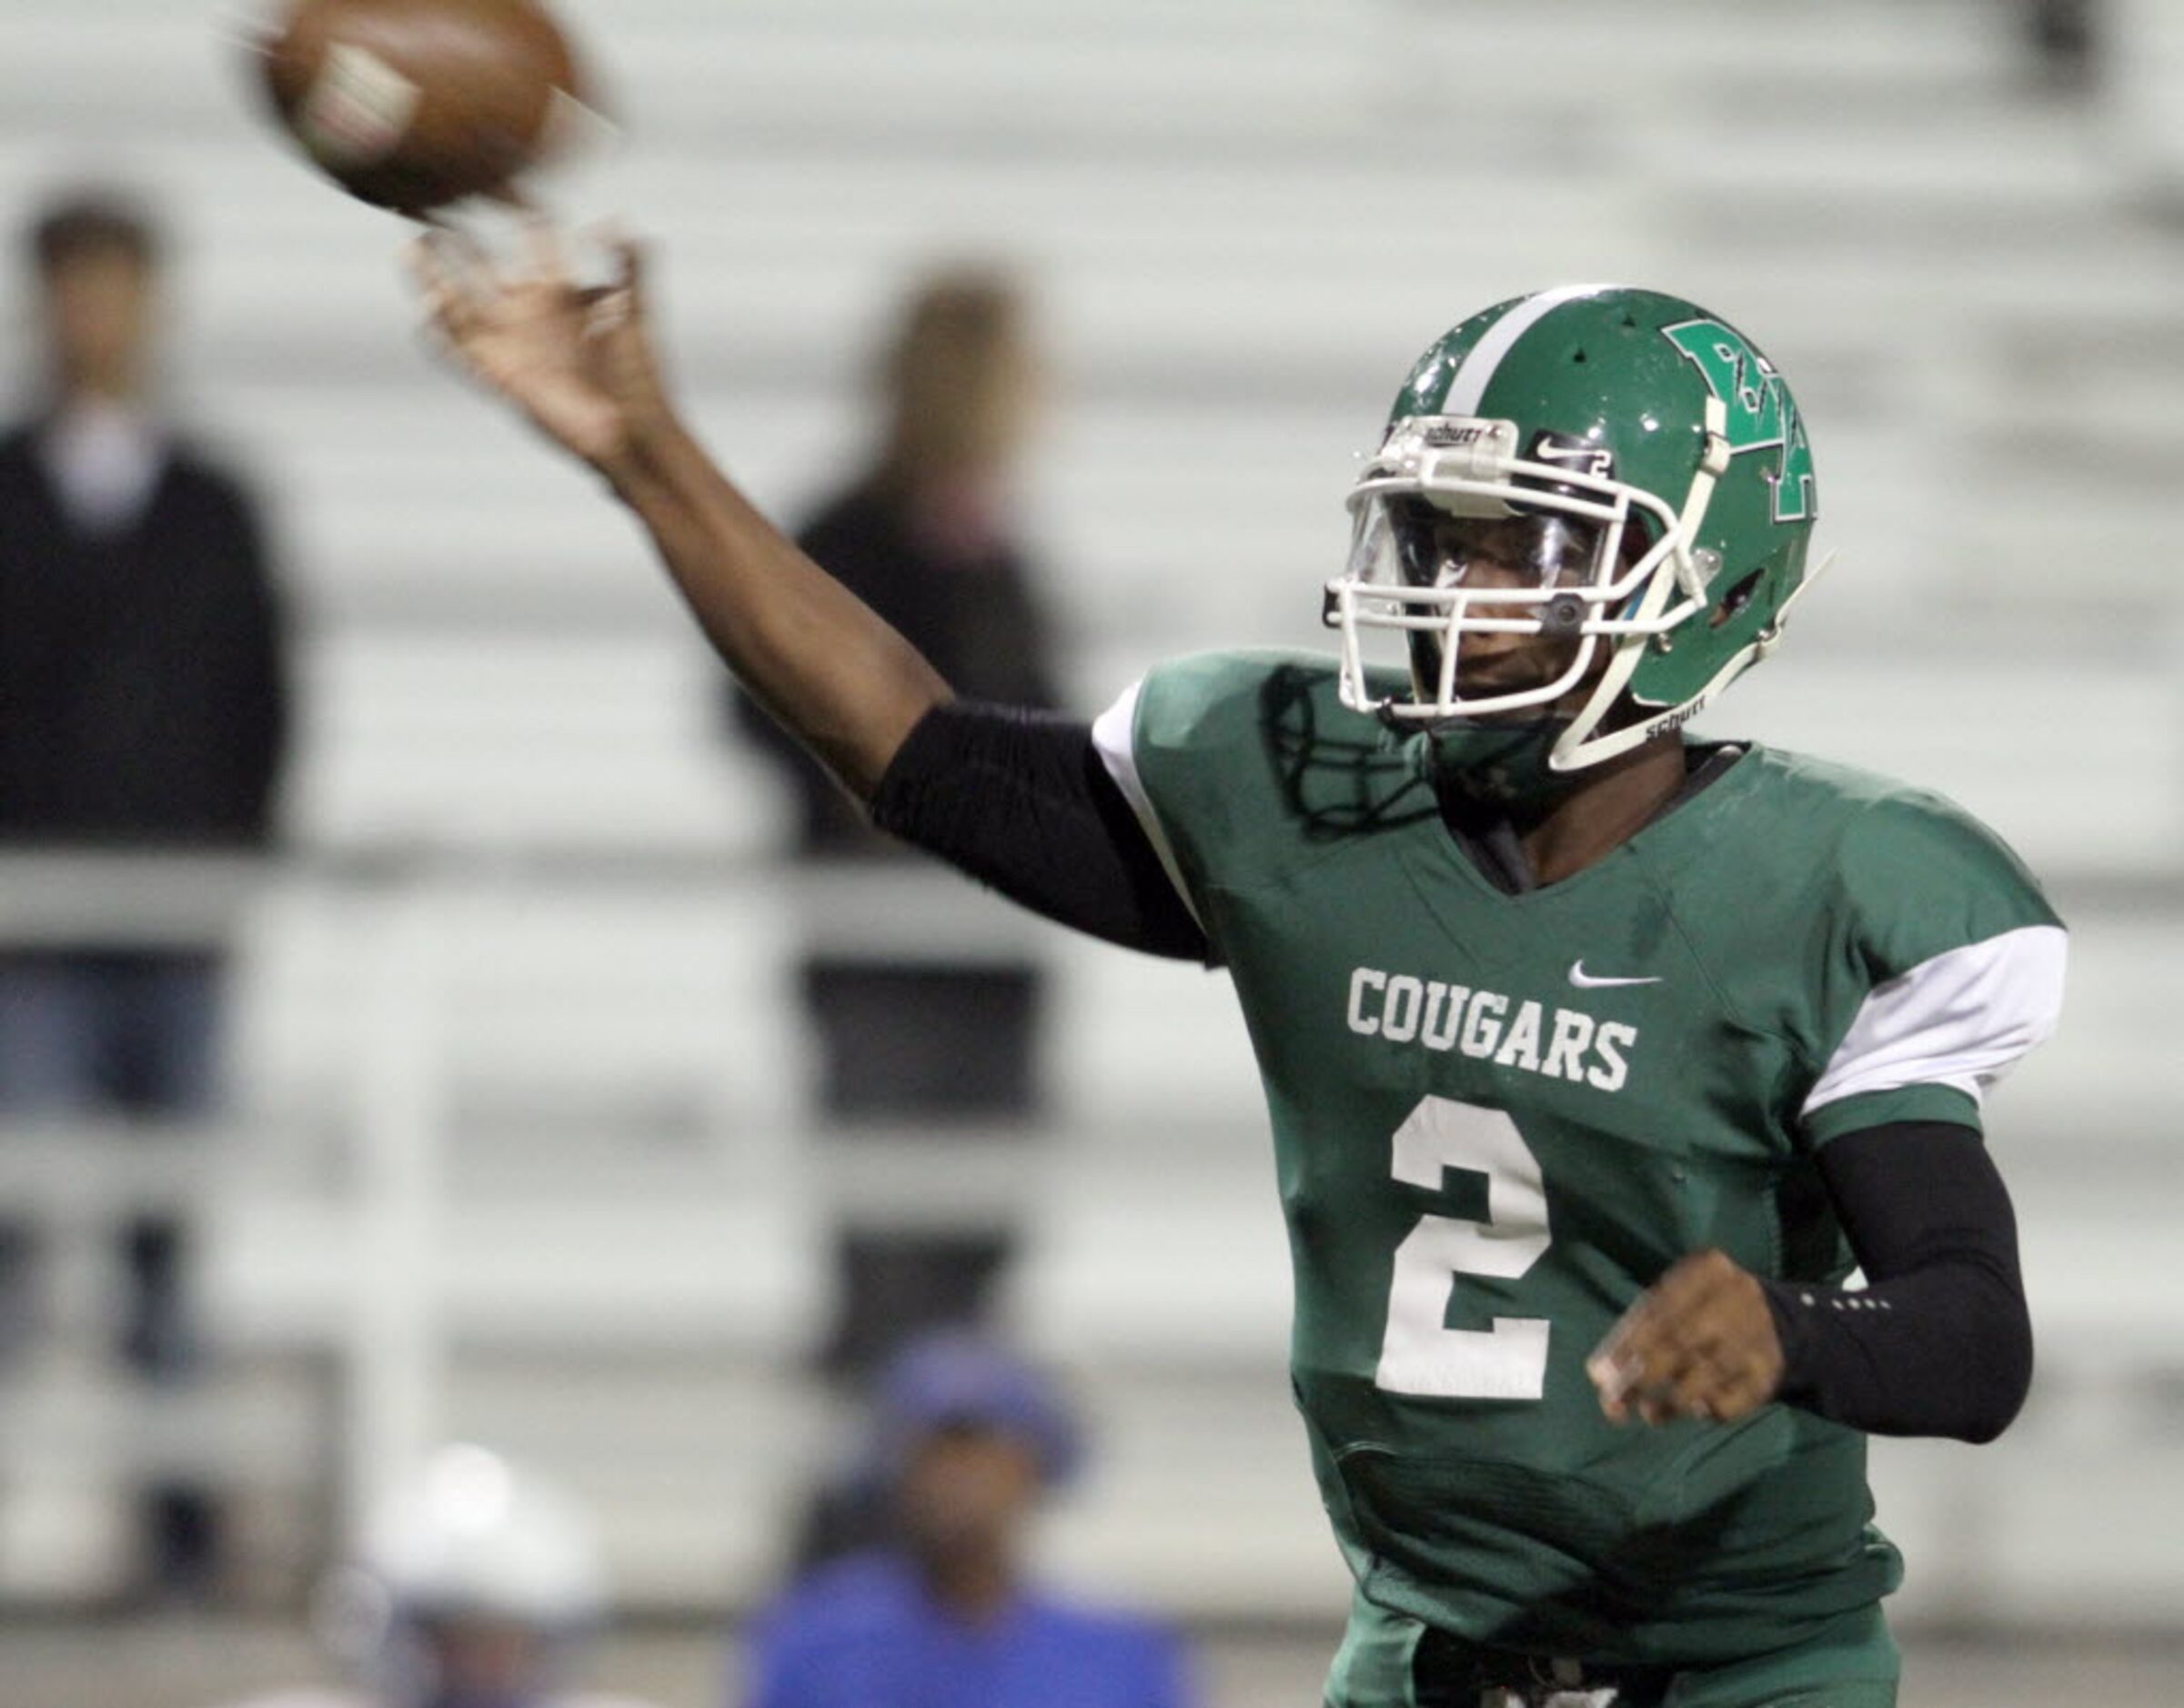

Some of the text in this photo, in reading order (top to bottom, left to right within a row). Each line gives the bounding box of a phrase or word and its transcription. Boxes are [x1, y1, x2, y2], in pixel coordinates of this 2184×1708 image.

[1590, 449, 1611, 479] 2
[1346, 967, 1636, 1092] COUGARS
[1374, 1093, 1552, 1400] 2
